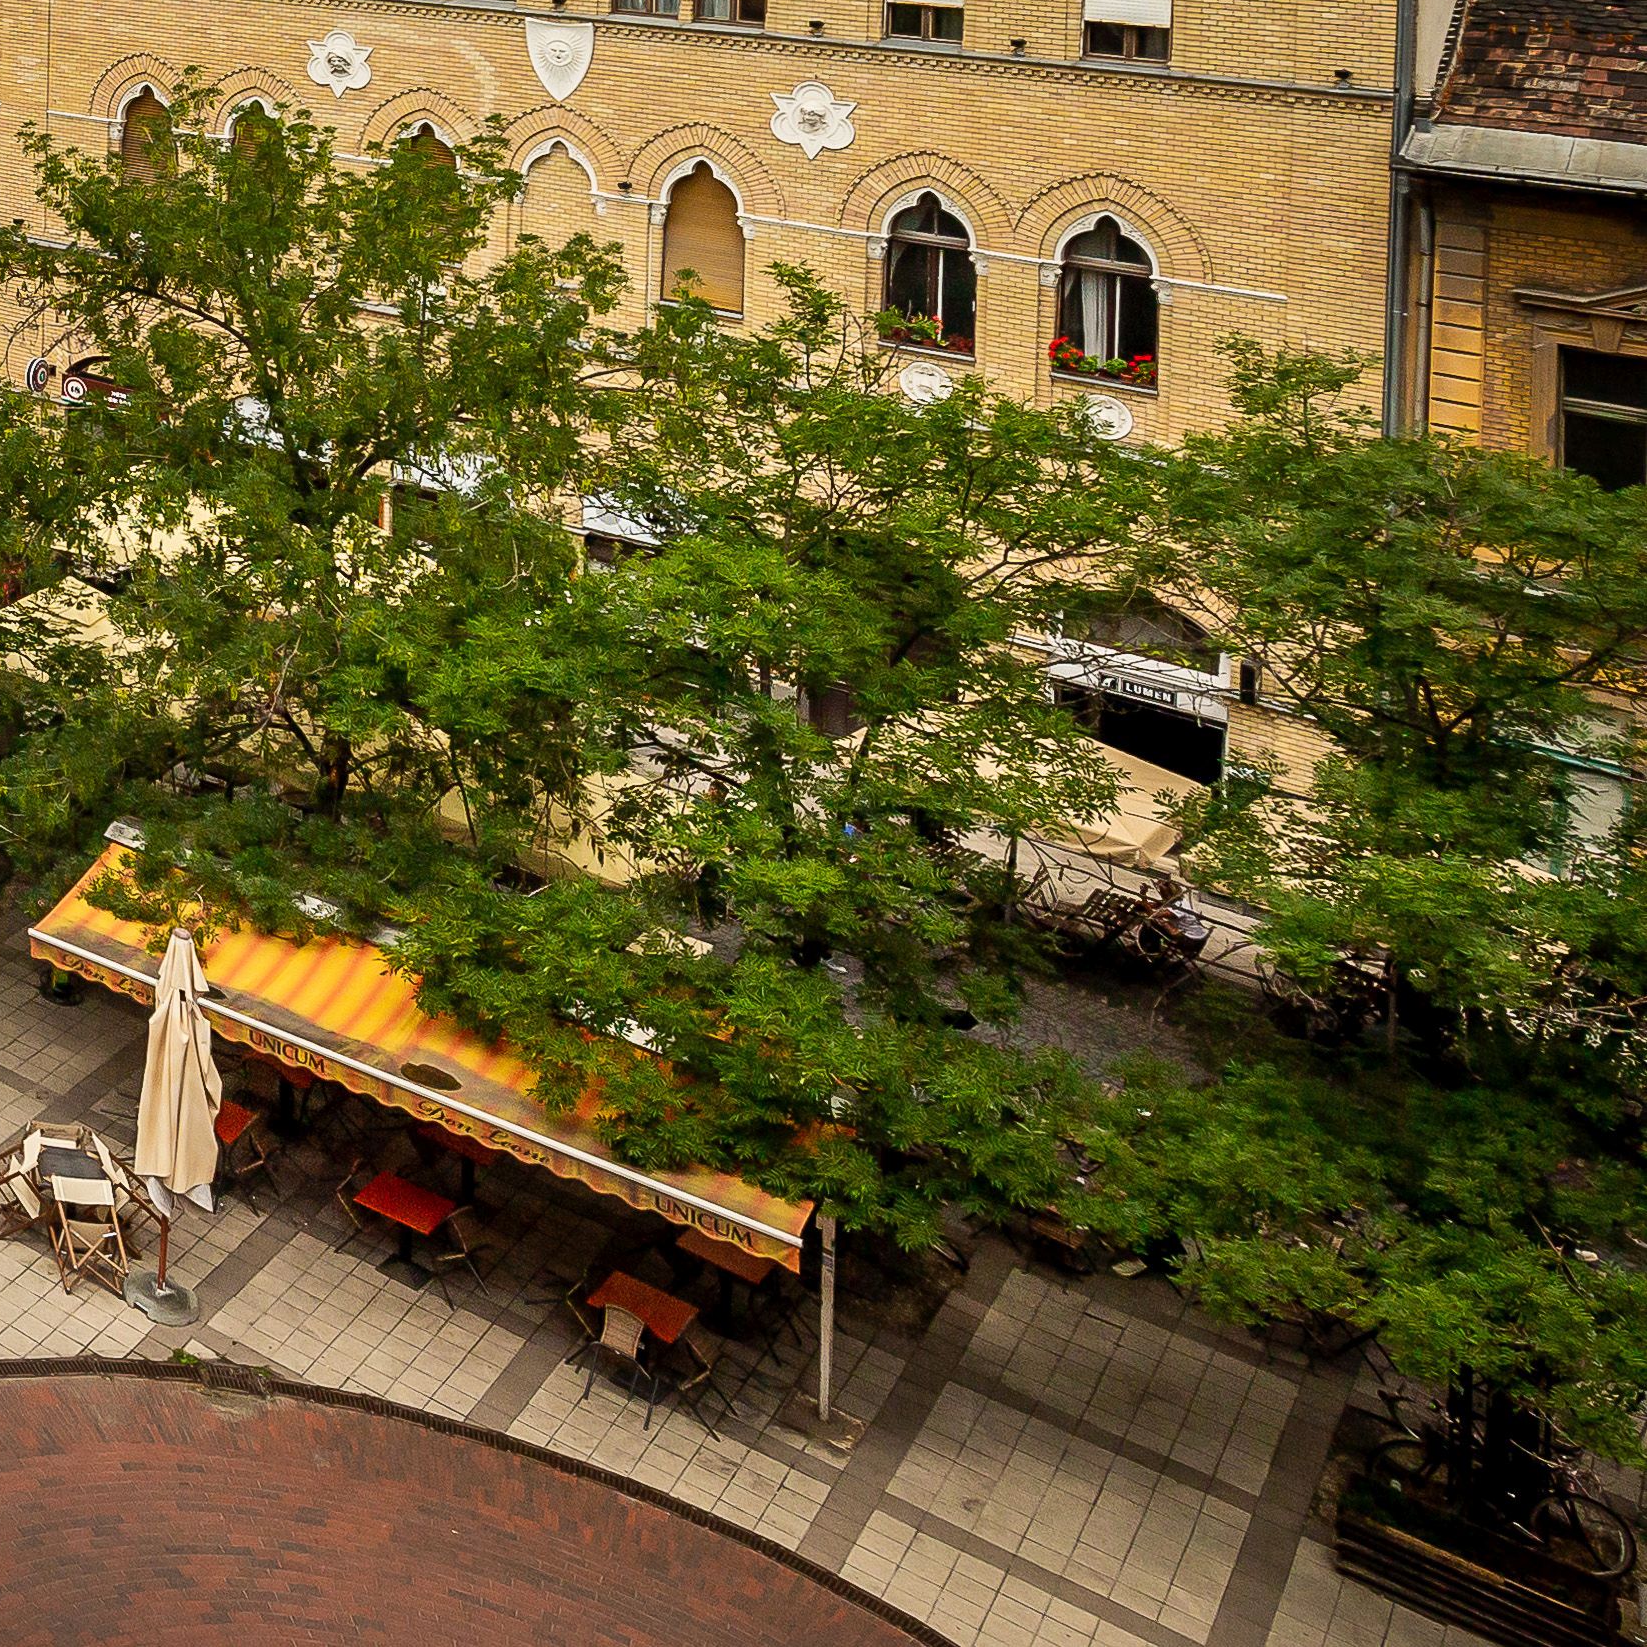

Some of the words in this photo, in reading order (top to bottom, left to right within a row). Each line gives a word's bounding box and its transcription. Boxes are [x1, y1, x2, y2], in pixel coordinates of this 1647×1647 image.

[1125, 682, 1172, 702] LUMEN
[248, 1028, 327, 1074] UNICUM
[654, 1194, 755, 1247] UNICUM
